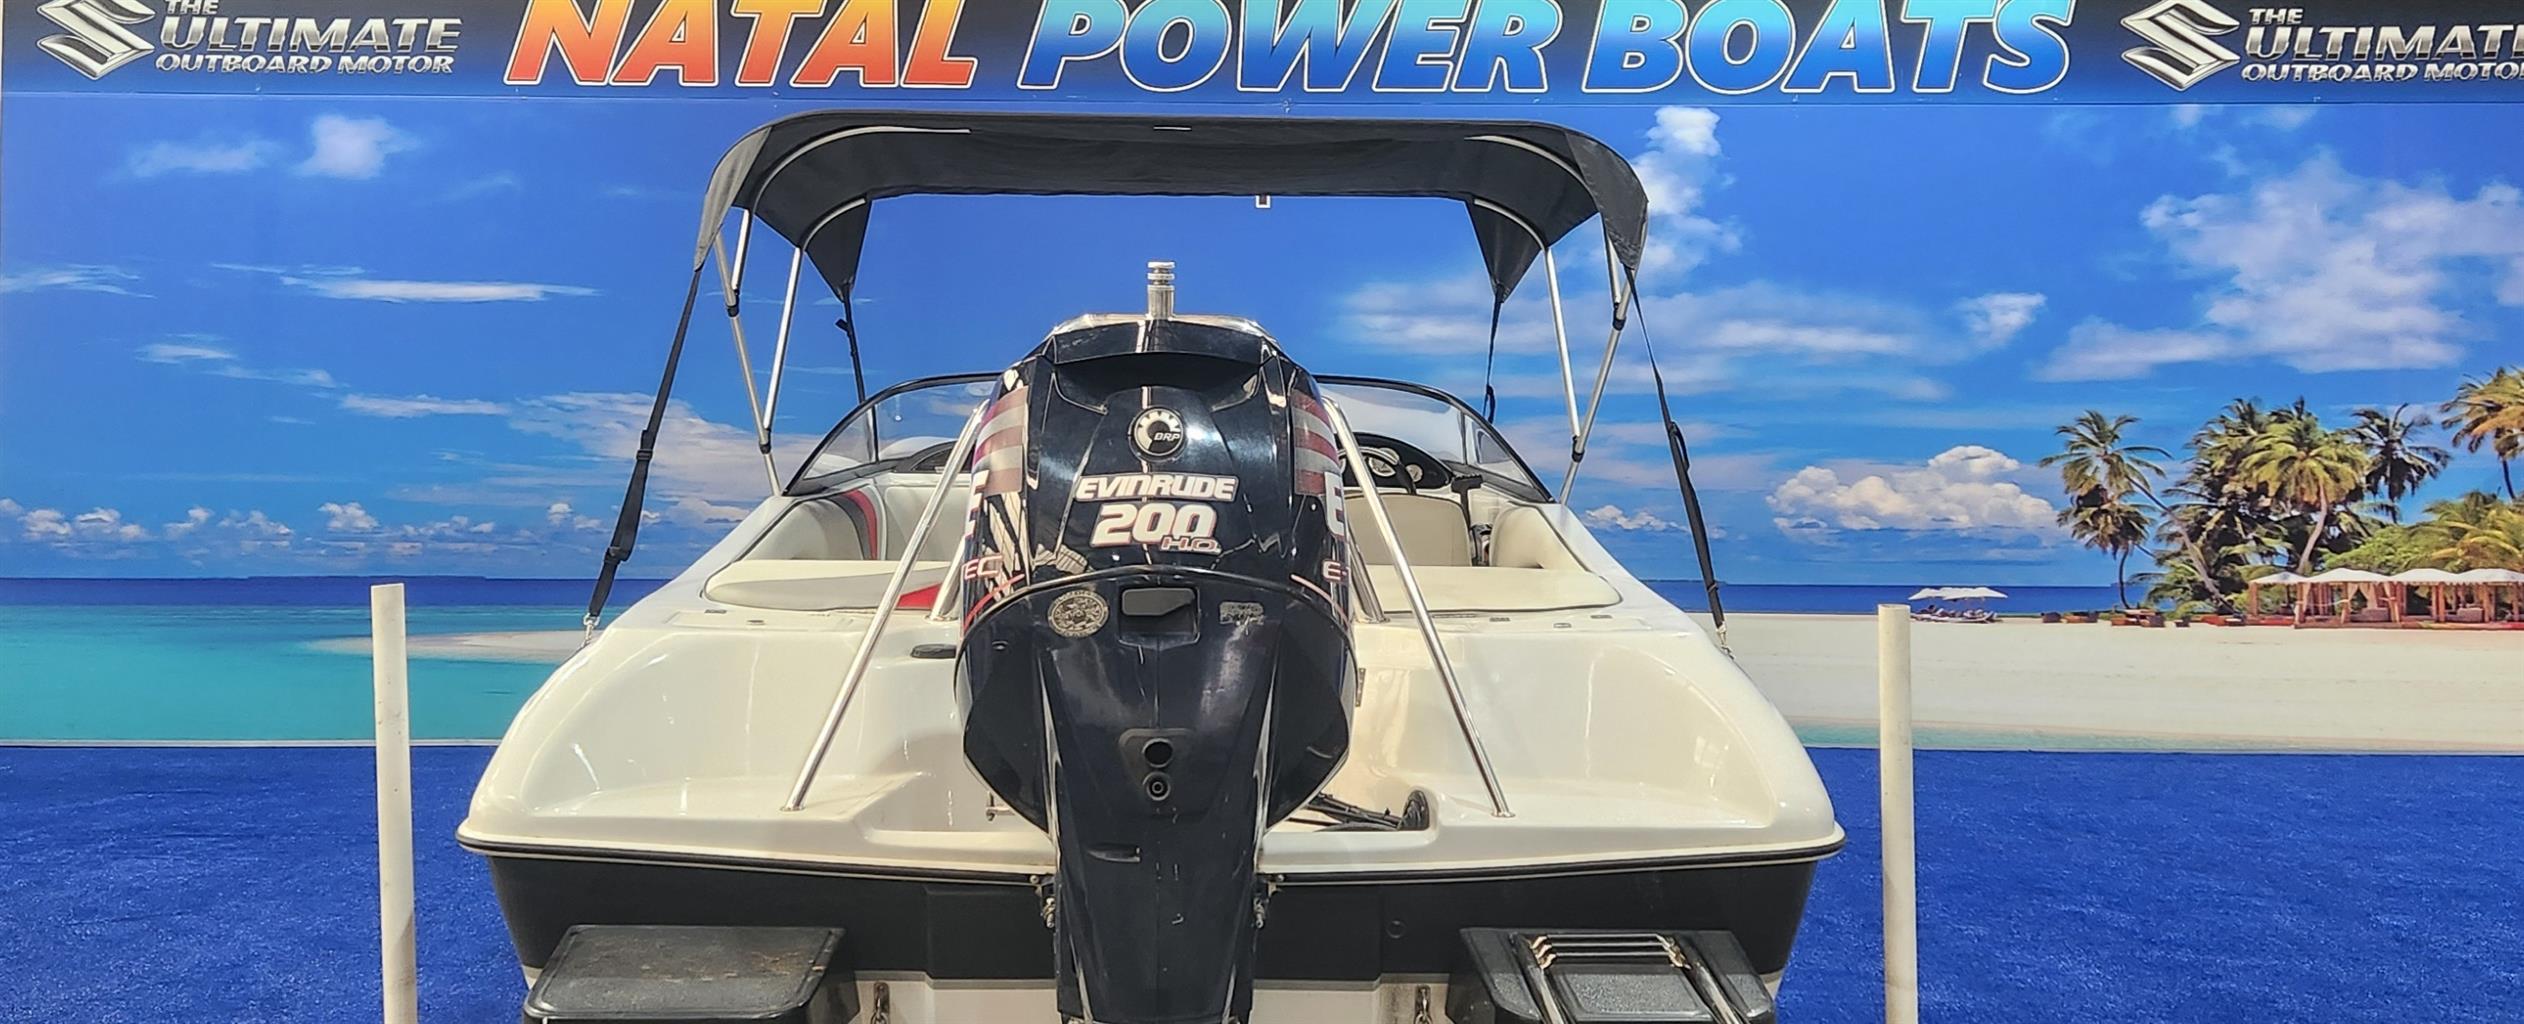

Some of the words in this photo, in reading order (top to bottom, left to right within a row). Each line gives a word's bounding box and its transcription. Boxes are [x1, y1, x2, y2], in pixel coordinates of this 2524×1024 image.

[164, 0, 219, 15] THE
[2248, 7, 2304, 25] THE
[159, 16, 462, 53] ULTIMATE
[504, 0, 978, 87] NATAL
[1018, 0, 1563, 92] POWER
[1583, 0, 2074, 95] BOATS
[155, 53, 333, 73] OUTBOARD
[337, 54, 455, 74] MOTOR
[2241, 62, 2419, 82] OUTBOARD
[1075, 473, 1237, 500] EVINRUDE
[1090, 502, 1217, 548] 200
